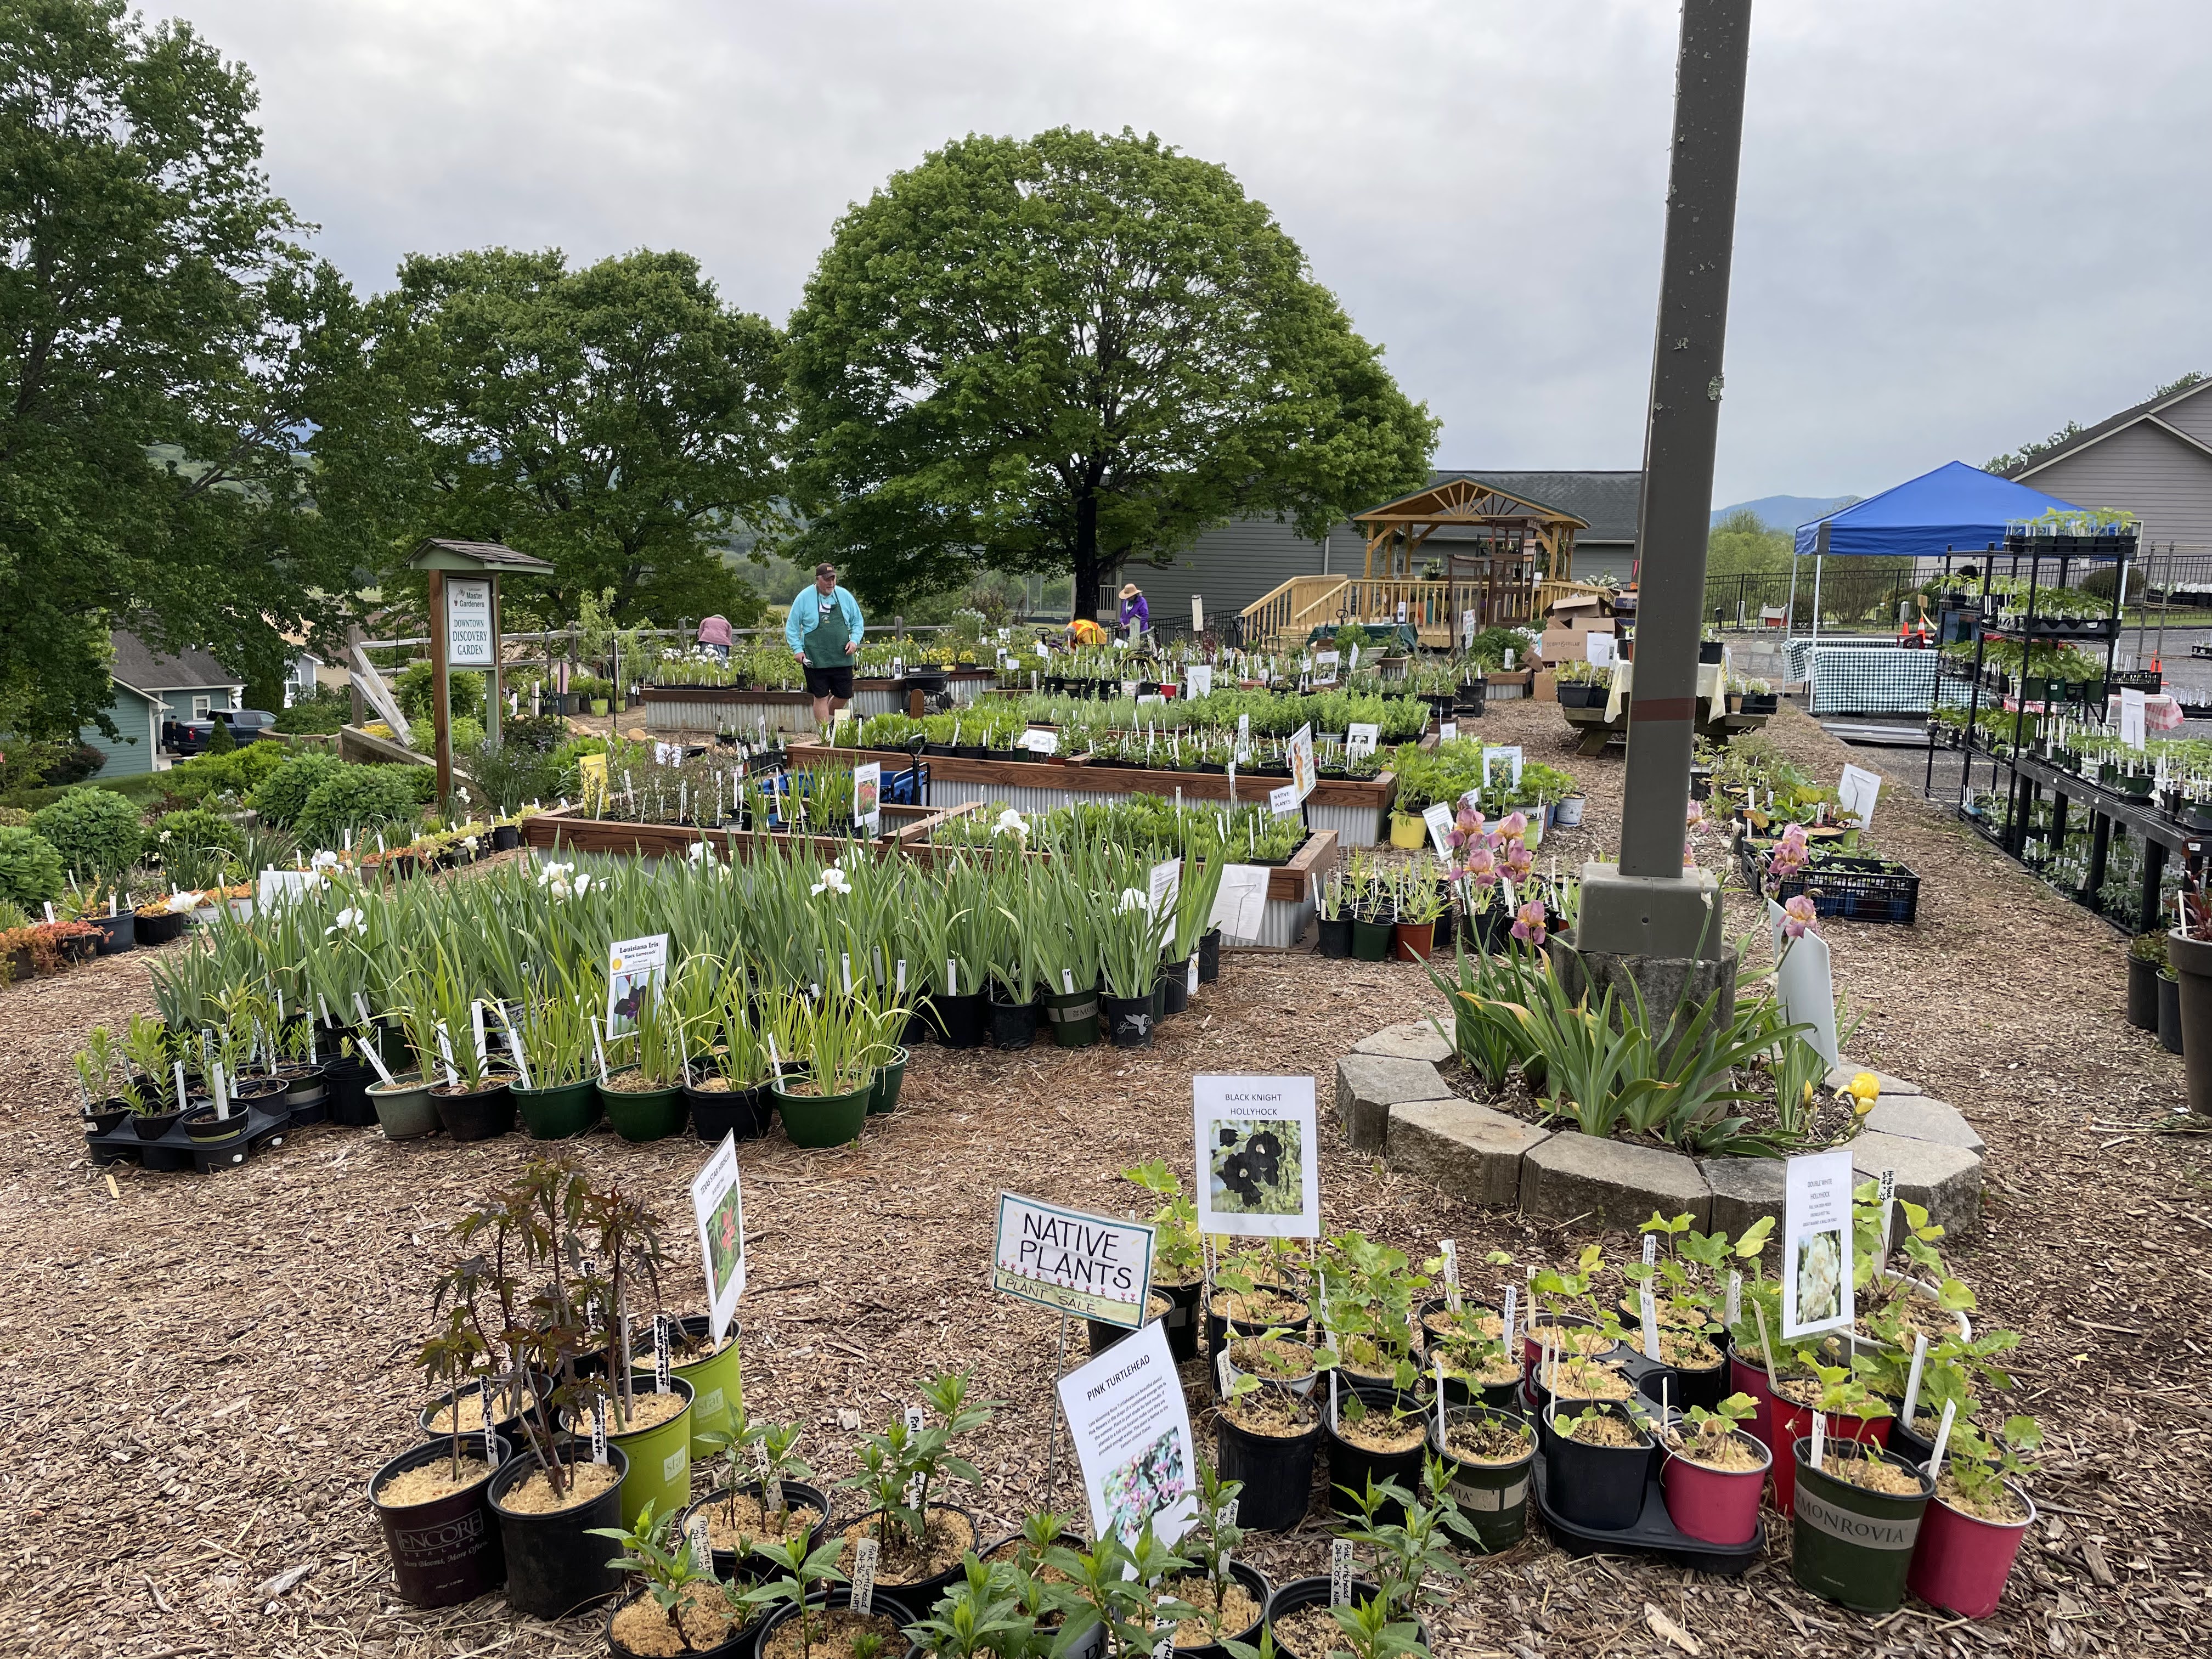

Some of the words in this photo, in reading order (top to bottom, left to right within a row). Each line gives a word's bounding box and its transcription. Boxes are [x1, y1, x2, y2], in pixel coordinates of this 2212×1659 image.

[454, 619, 484, 628] DOWNTOWN
[453, 631, 488, 641] DISCOVERY
[458, 645, 483, 655] GARDEN
[619, 944, 647, 953] Louisiana
[701, 1178, 710, 1195] TEXAS
[710, 1167, 719, 1183] STAR
[1807, 1180, 1821, 1188] DOUBLE
[1810, 1191, 1830, 1199] HOLLYHOCK
[1024, 1213, 1119, 1261] NATIVE
[1020, 1240, 1132, 1289] PLANTS
[1006, 1278, 1048, 1299] PLANT
[1058, 1296, 1097, 1314] SALE
[1007, 1274, 1028, 1285] COUNTY
[1059, 1289, 1102, 1305] GARDENERS
[1087, 1383, 1105, 1401] PINK
[1105, 1355, 1150, 1389] TURTLEHEAD
[697, 1395, 719, 1409] star
[1095, 1411, 1110, 1422] blooming
[1117, 1394, 1135, 1408] Turtleheads
[1140, 1382, 1153, 1393] beautiful
[1132, 1407, 1141, 1415] shade
[1096, 1422, 1108, 1431] flowers
[1116, 1409, 1125, 1418] shape
[1131, 1395, 1147, 1407] turtlehead
[1098, 1436, 1110, 1448] planted
[1127, 1417, 1138, 1426] location
[1138, 1410, 1147, 1419] make
[1120, 1438, 1132, 1448] Eastern
[1131, 1431, 1142, 1441] United
[1099, 1442, 1112, 1457] provided
[1112, 1435, 1124, 1446] enough
[667, 1451, 684, 1472] star
[699, 1520, 708, 1539] Pink
[1802, 1497, 1904, 1543] MONROVIA
[402, 1515, 481, 1550] ENCORE
[418, 1558, 445, 1567] Blooms,
[447, 1550, 467, 1562] More
[866, 1544, 877, 1562] Pink
[1344, 1543, 1352, 1560] Pink
[861, 1562, 873, 1609] Turtlehead
[1342, 1564, 1351, 1599] urtlehead
